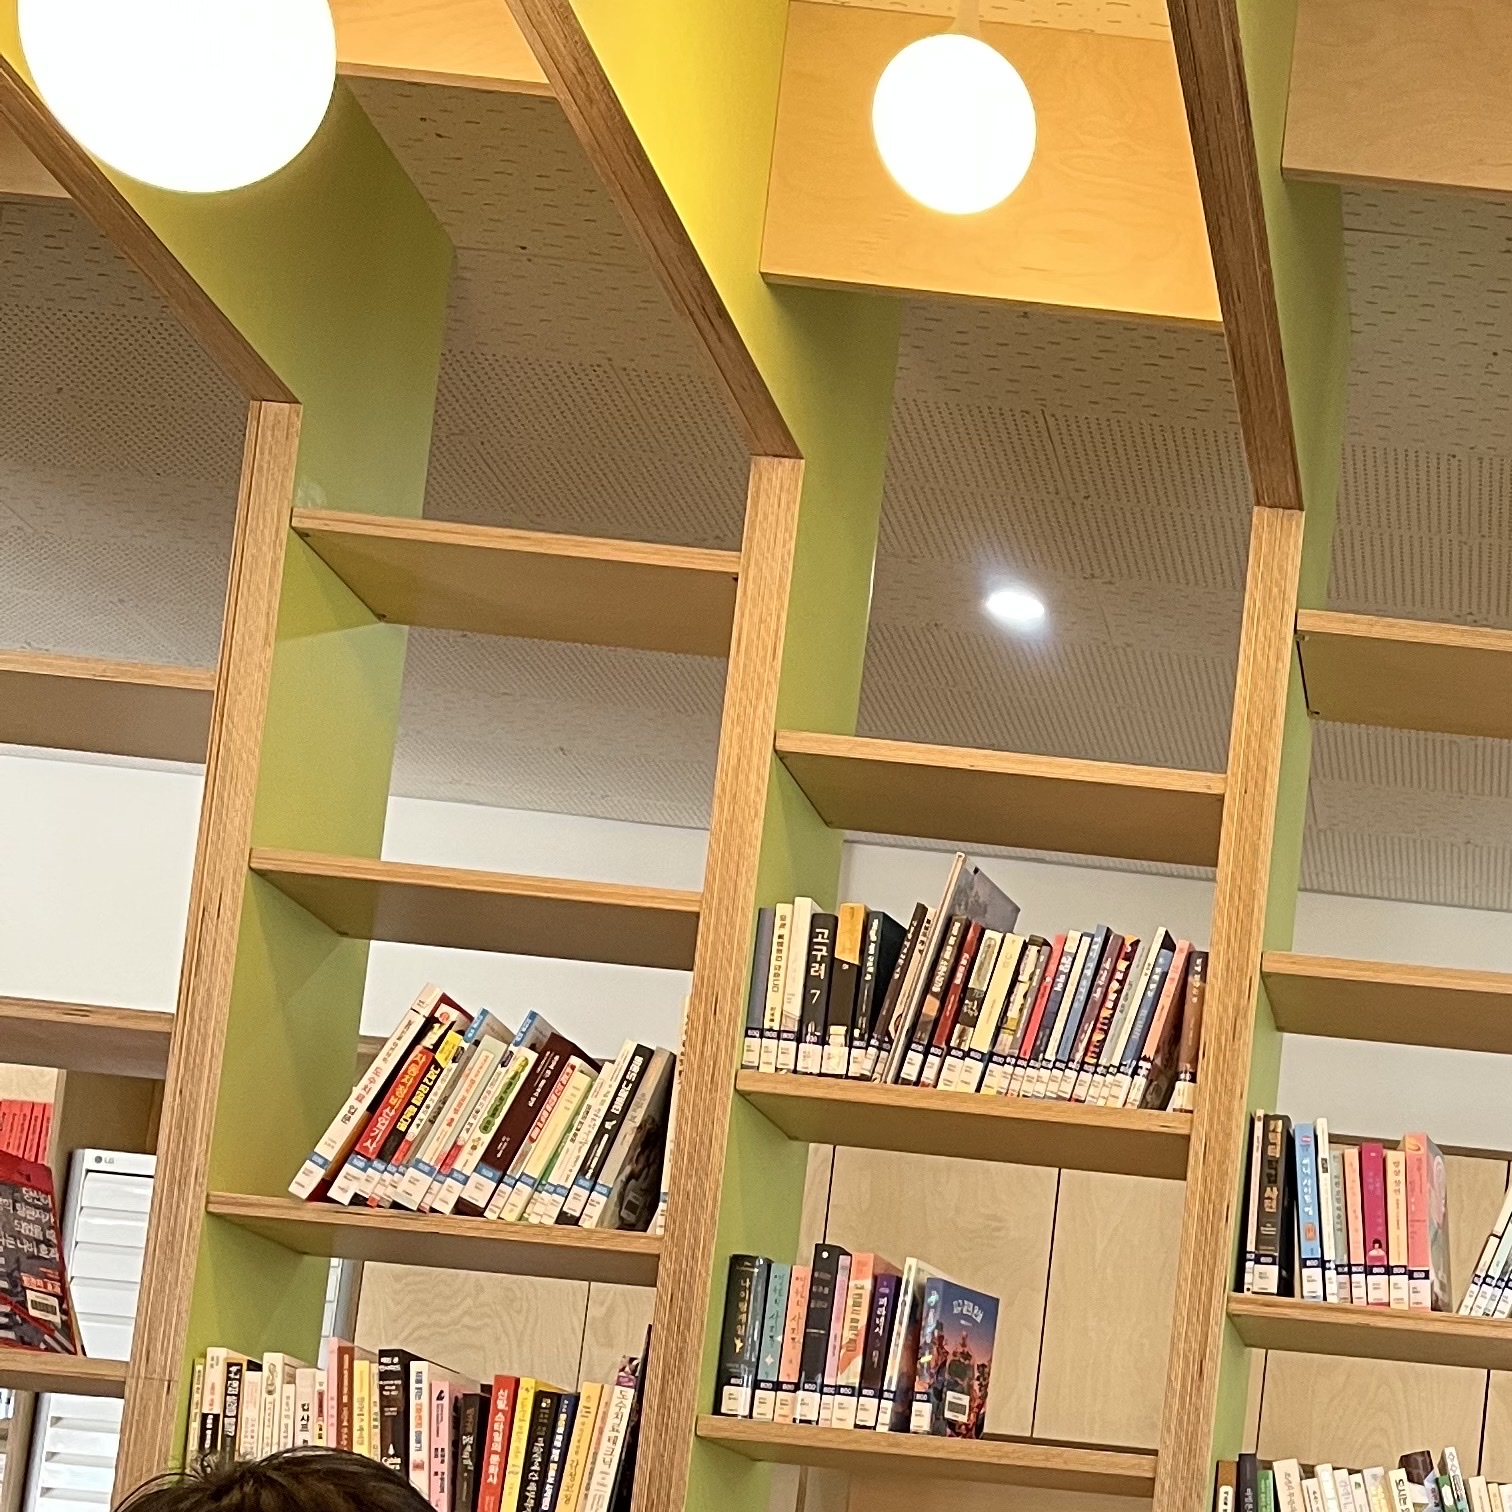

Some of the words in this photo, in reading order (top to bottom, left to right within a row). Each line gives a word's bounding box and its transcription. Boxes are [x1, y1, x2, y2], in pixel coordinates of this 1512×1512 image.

[810, 928, 830, 980] 고구려
[810, 989, 821, 1004] 7
[1394, 1478, 1408, 1505] 도시는
